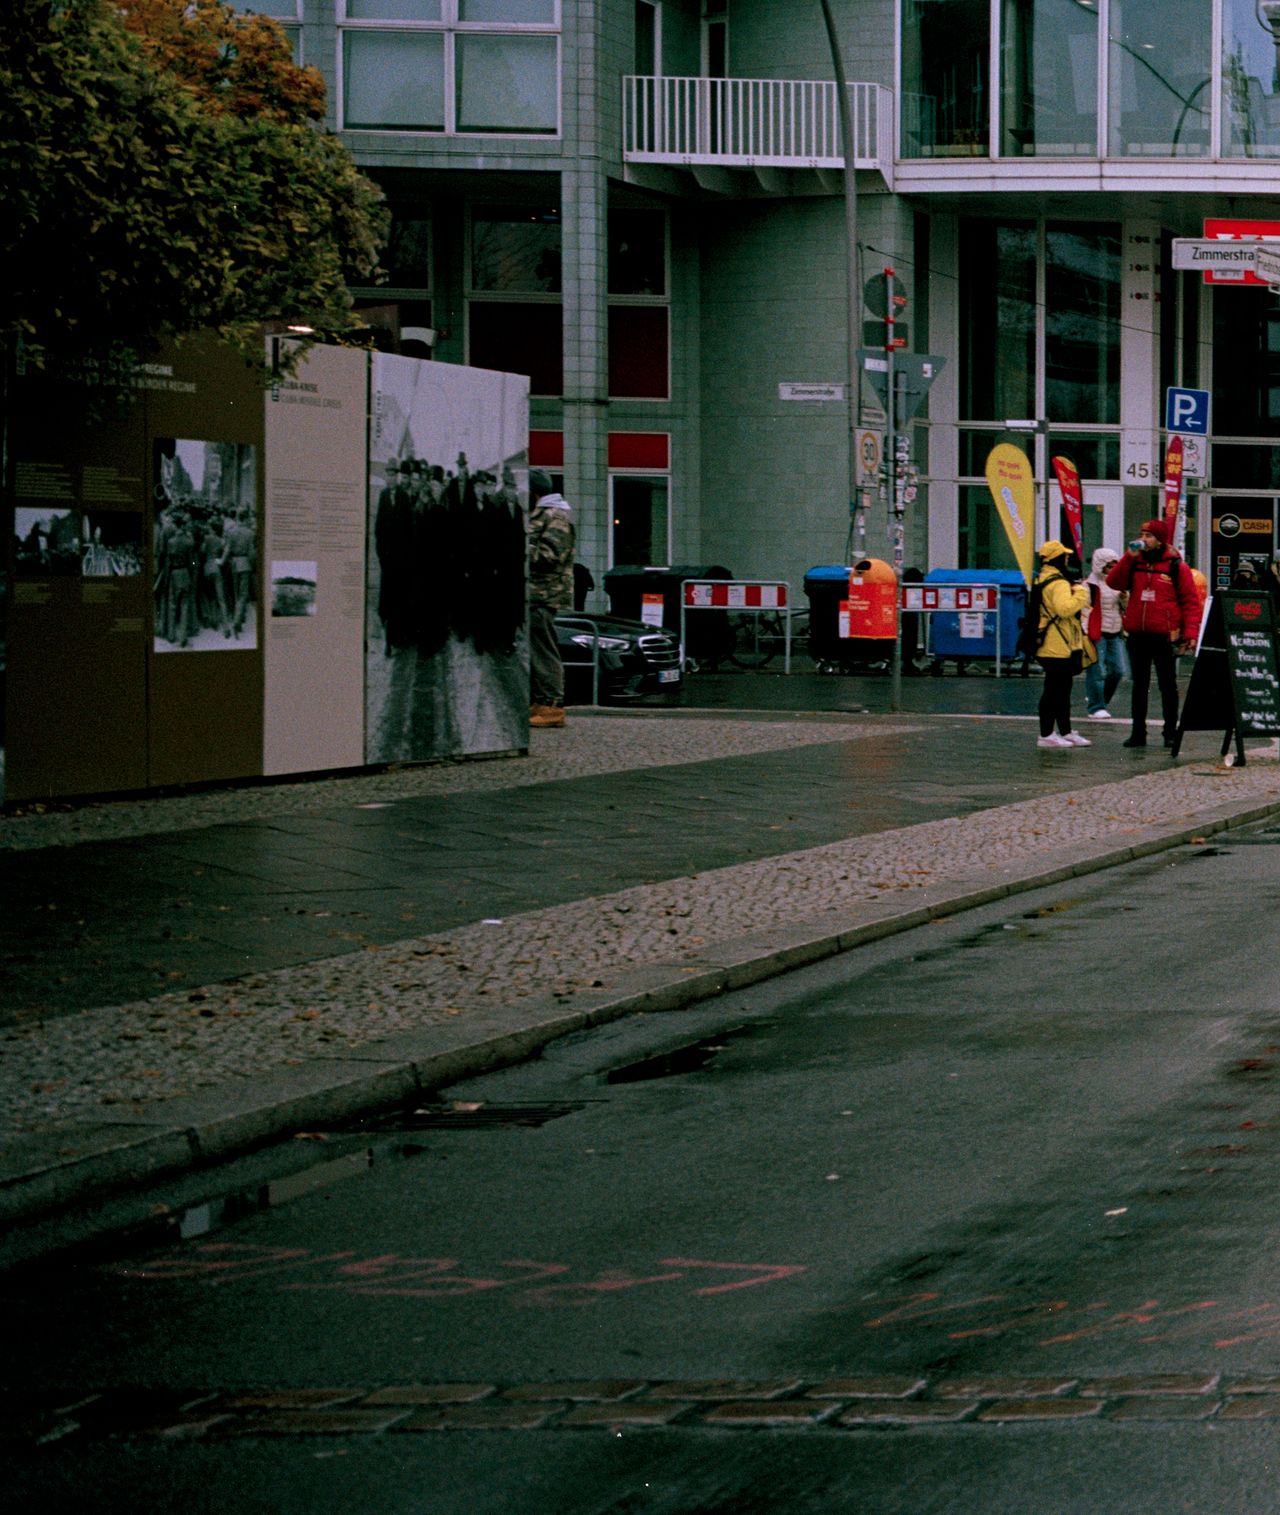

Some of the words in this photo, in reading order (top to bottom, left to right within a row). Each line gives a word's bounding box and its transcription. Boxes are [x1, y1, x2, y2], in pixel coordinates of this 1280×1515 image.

[1192, 246, 1255, 262] Zimmerstra
[1127, 463, 1149, 478] 45
[1243, 522, 1269, 530] CASH
